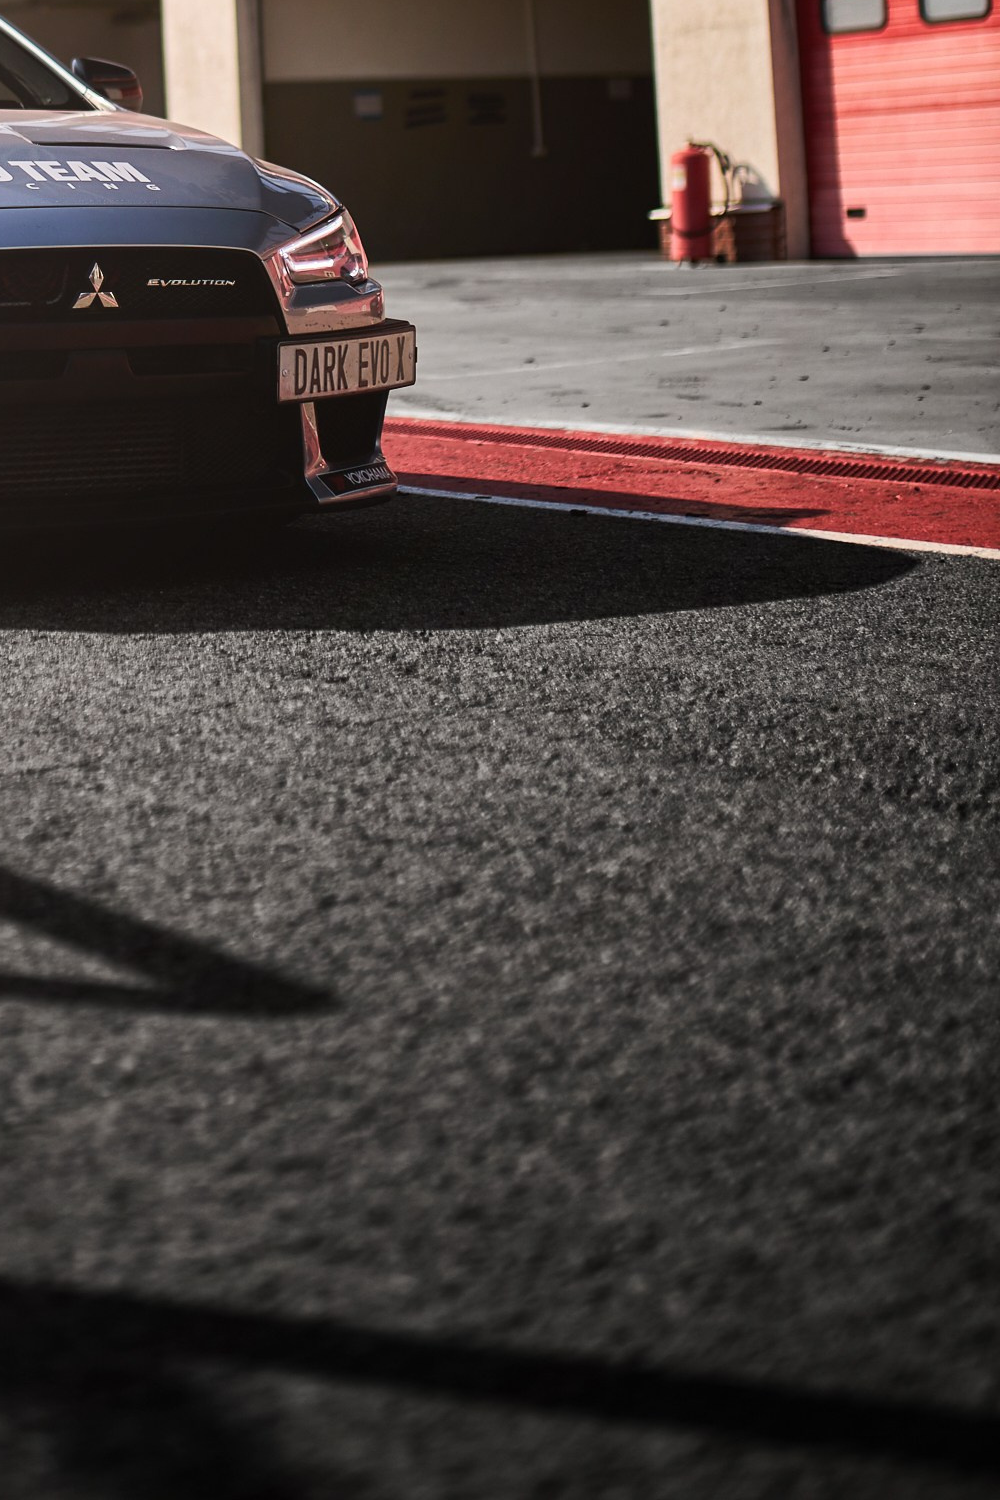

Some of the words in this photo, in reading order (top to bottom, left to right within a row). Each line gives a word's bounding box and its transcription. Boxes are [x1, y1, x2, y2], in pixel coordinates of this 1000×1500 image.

[7, 160, 152, 183] TEAM
[146, 278, 236, 287] EVOLUTION
[294, 343, 349, 396] DARK
[358, 338, 390, 388] EVO
[396, 335, 406, 382] X
[343, 466, 393, 485] YOKOHAMA
